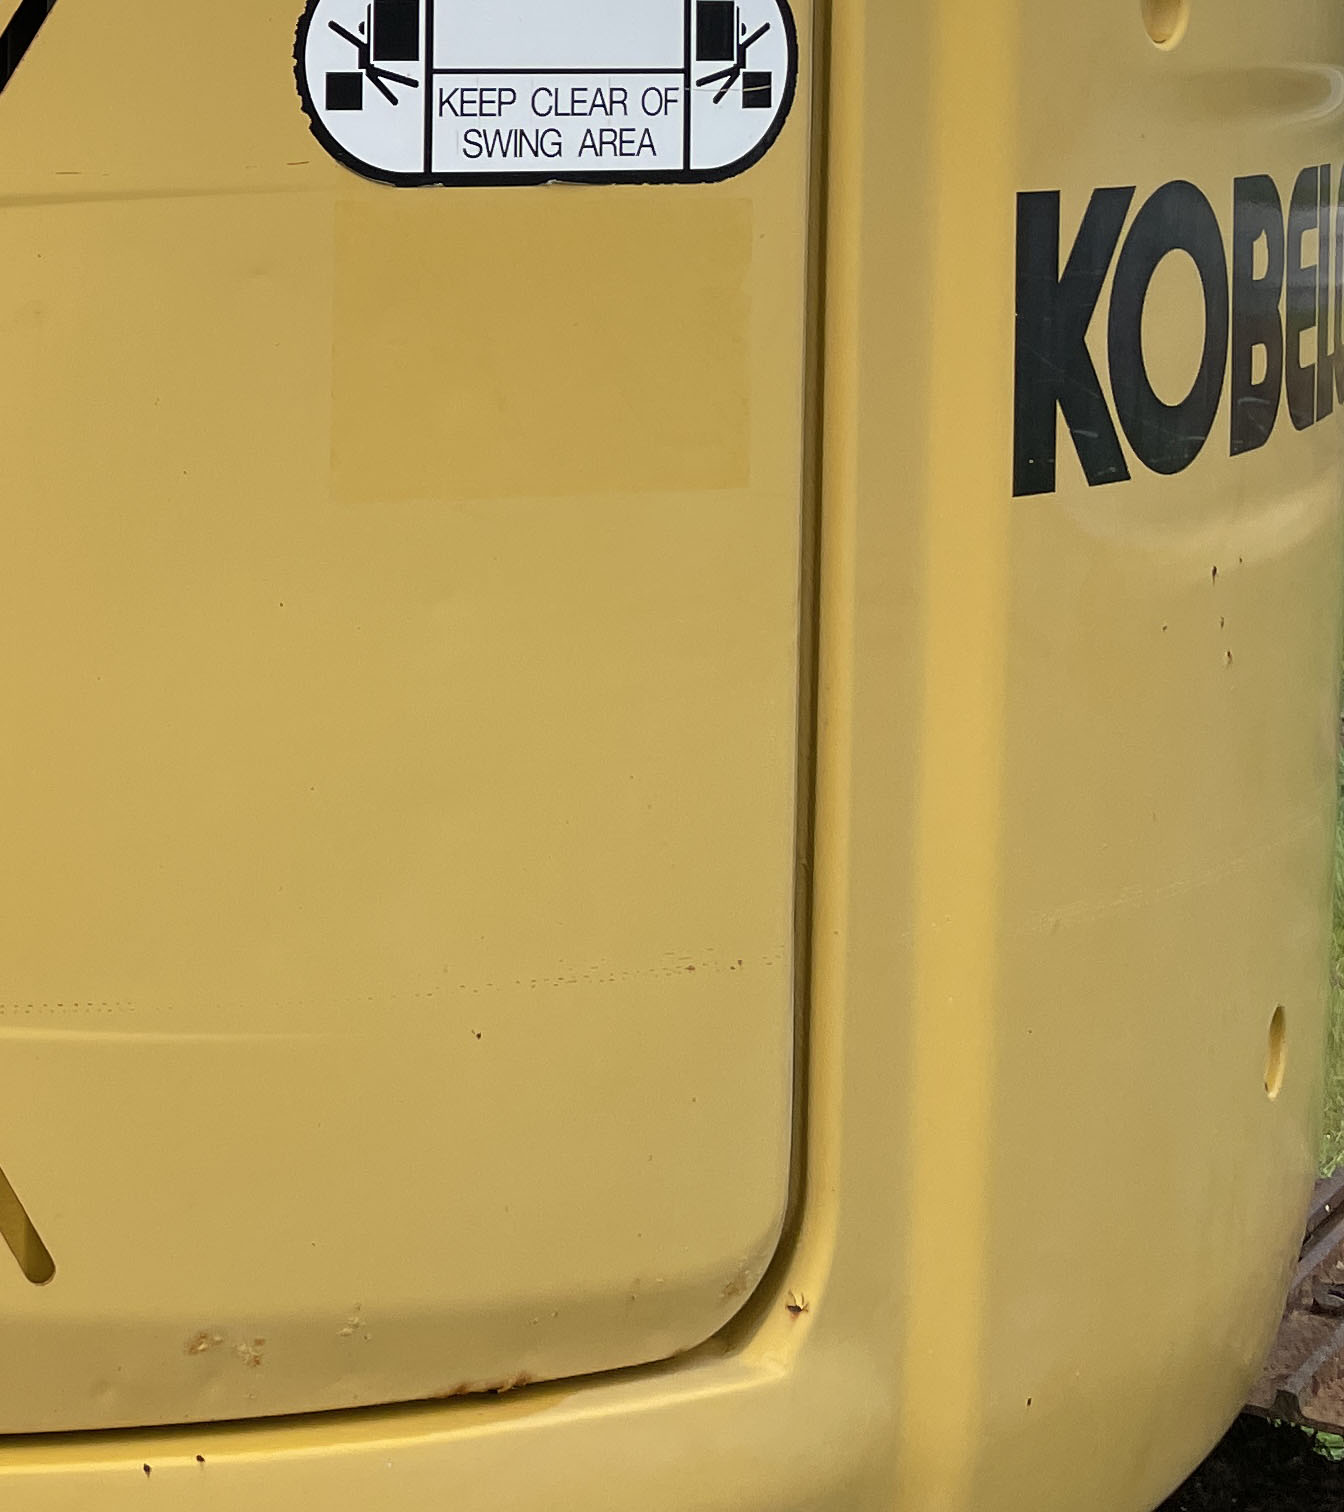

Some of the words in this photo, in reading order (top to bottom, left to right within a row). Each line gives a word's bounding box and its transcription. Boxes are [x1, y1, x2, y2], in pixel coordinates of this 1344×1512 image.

[438, 87, 517, 118] KEEP
[530, 86, 629, 117] CLEAR
[640, 86, 680, 117] OF
[461, 128, 563, 159] SWING
[577, 127, 658, 157] AREA
